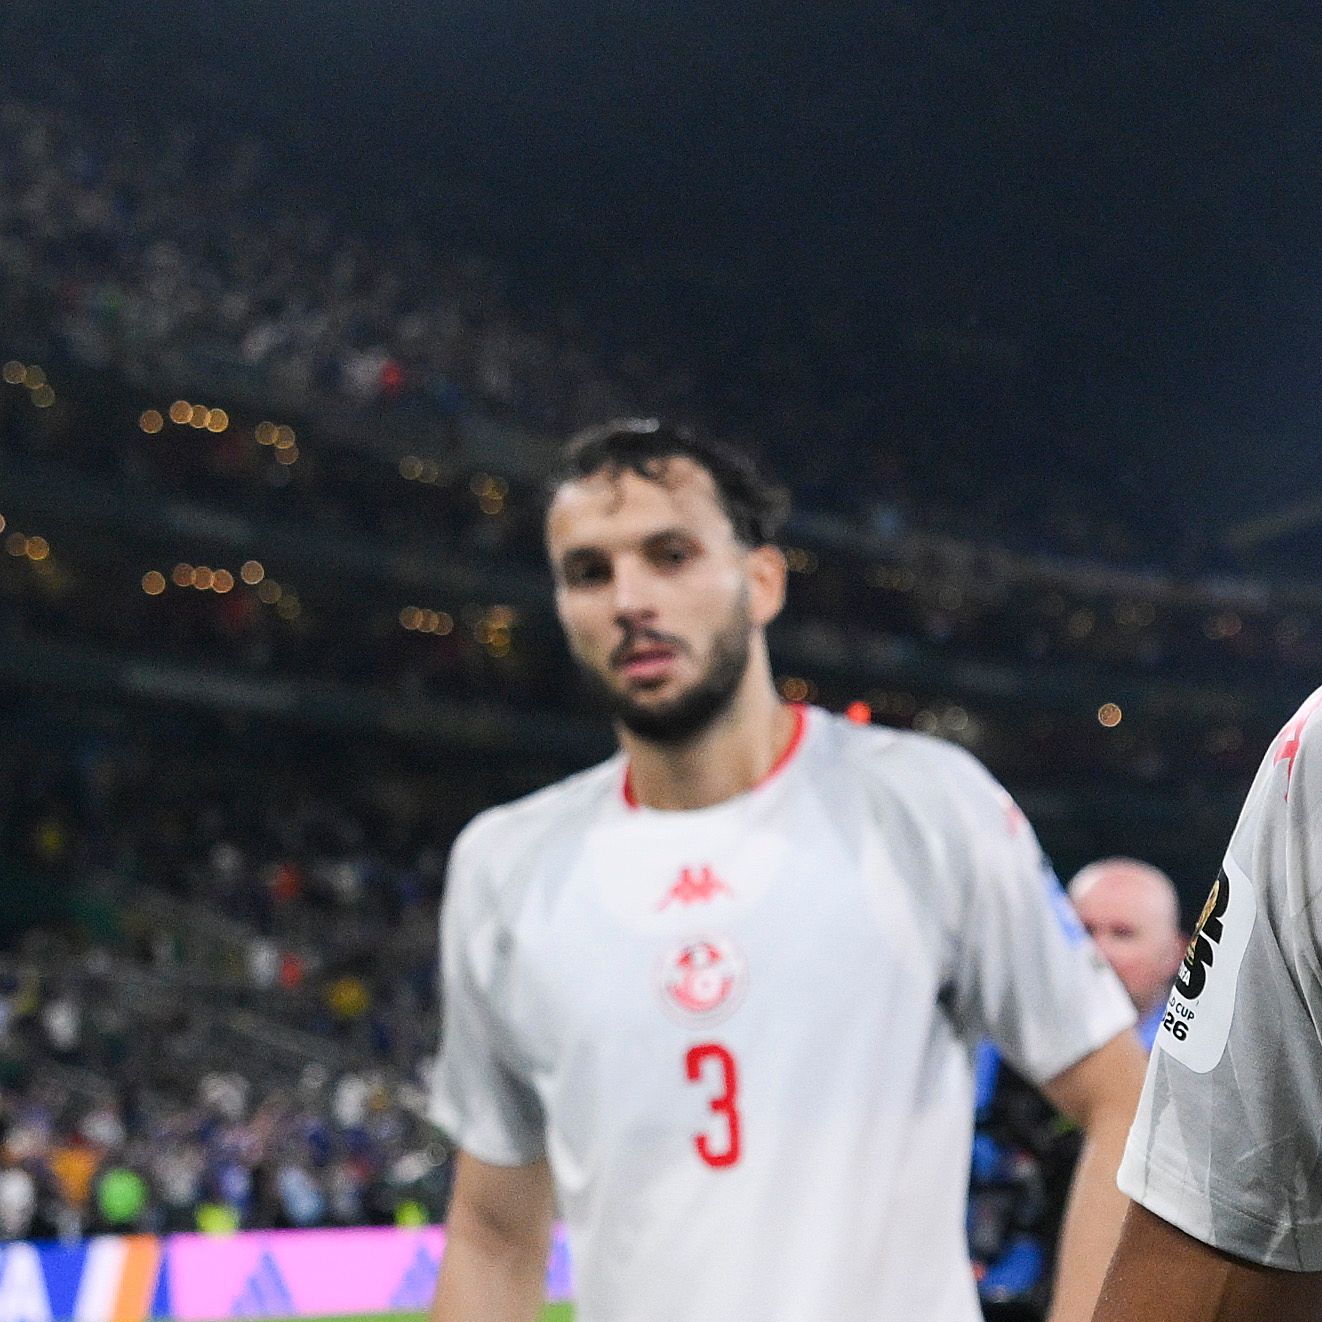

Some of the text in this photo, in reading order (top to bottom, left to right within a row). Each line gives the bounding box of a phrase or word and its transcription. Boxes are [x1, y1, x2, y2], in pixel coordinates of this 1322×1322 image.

[1175, 1002, 1195, 1021] CUP
[1162, 1012, 1189, 1041] 26
[684, 1043, 742, 1169] 3
